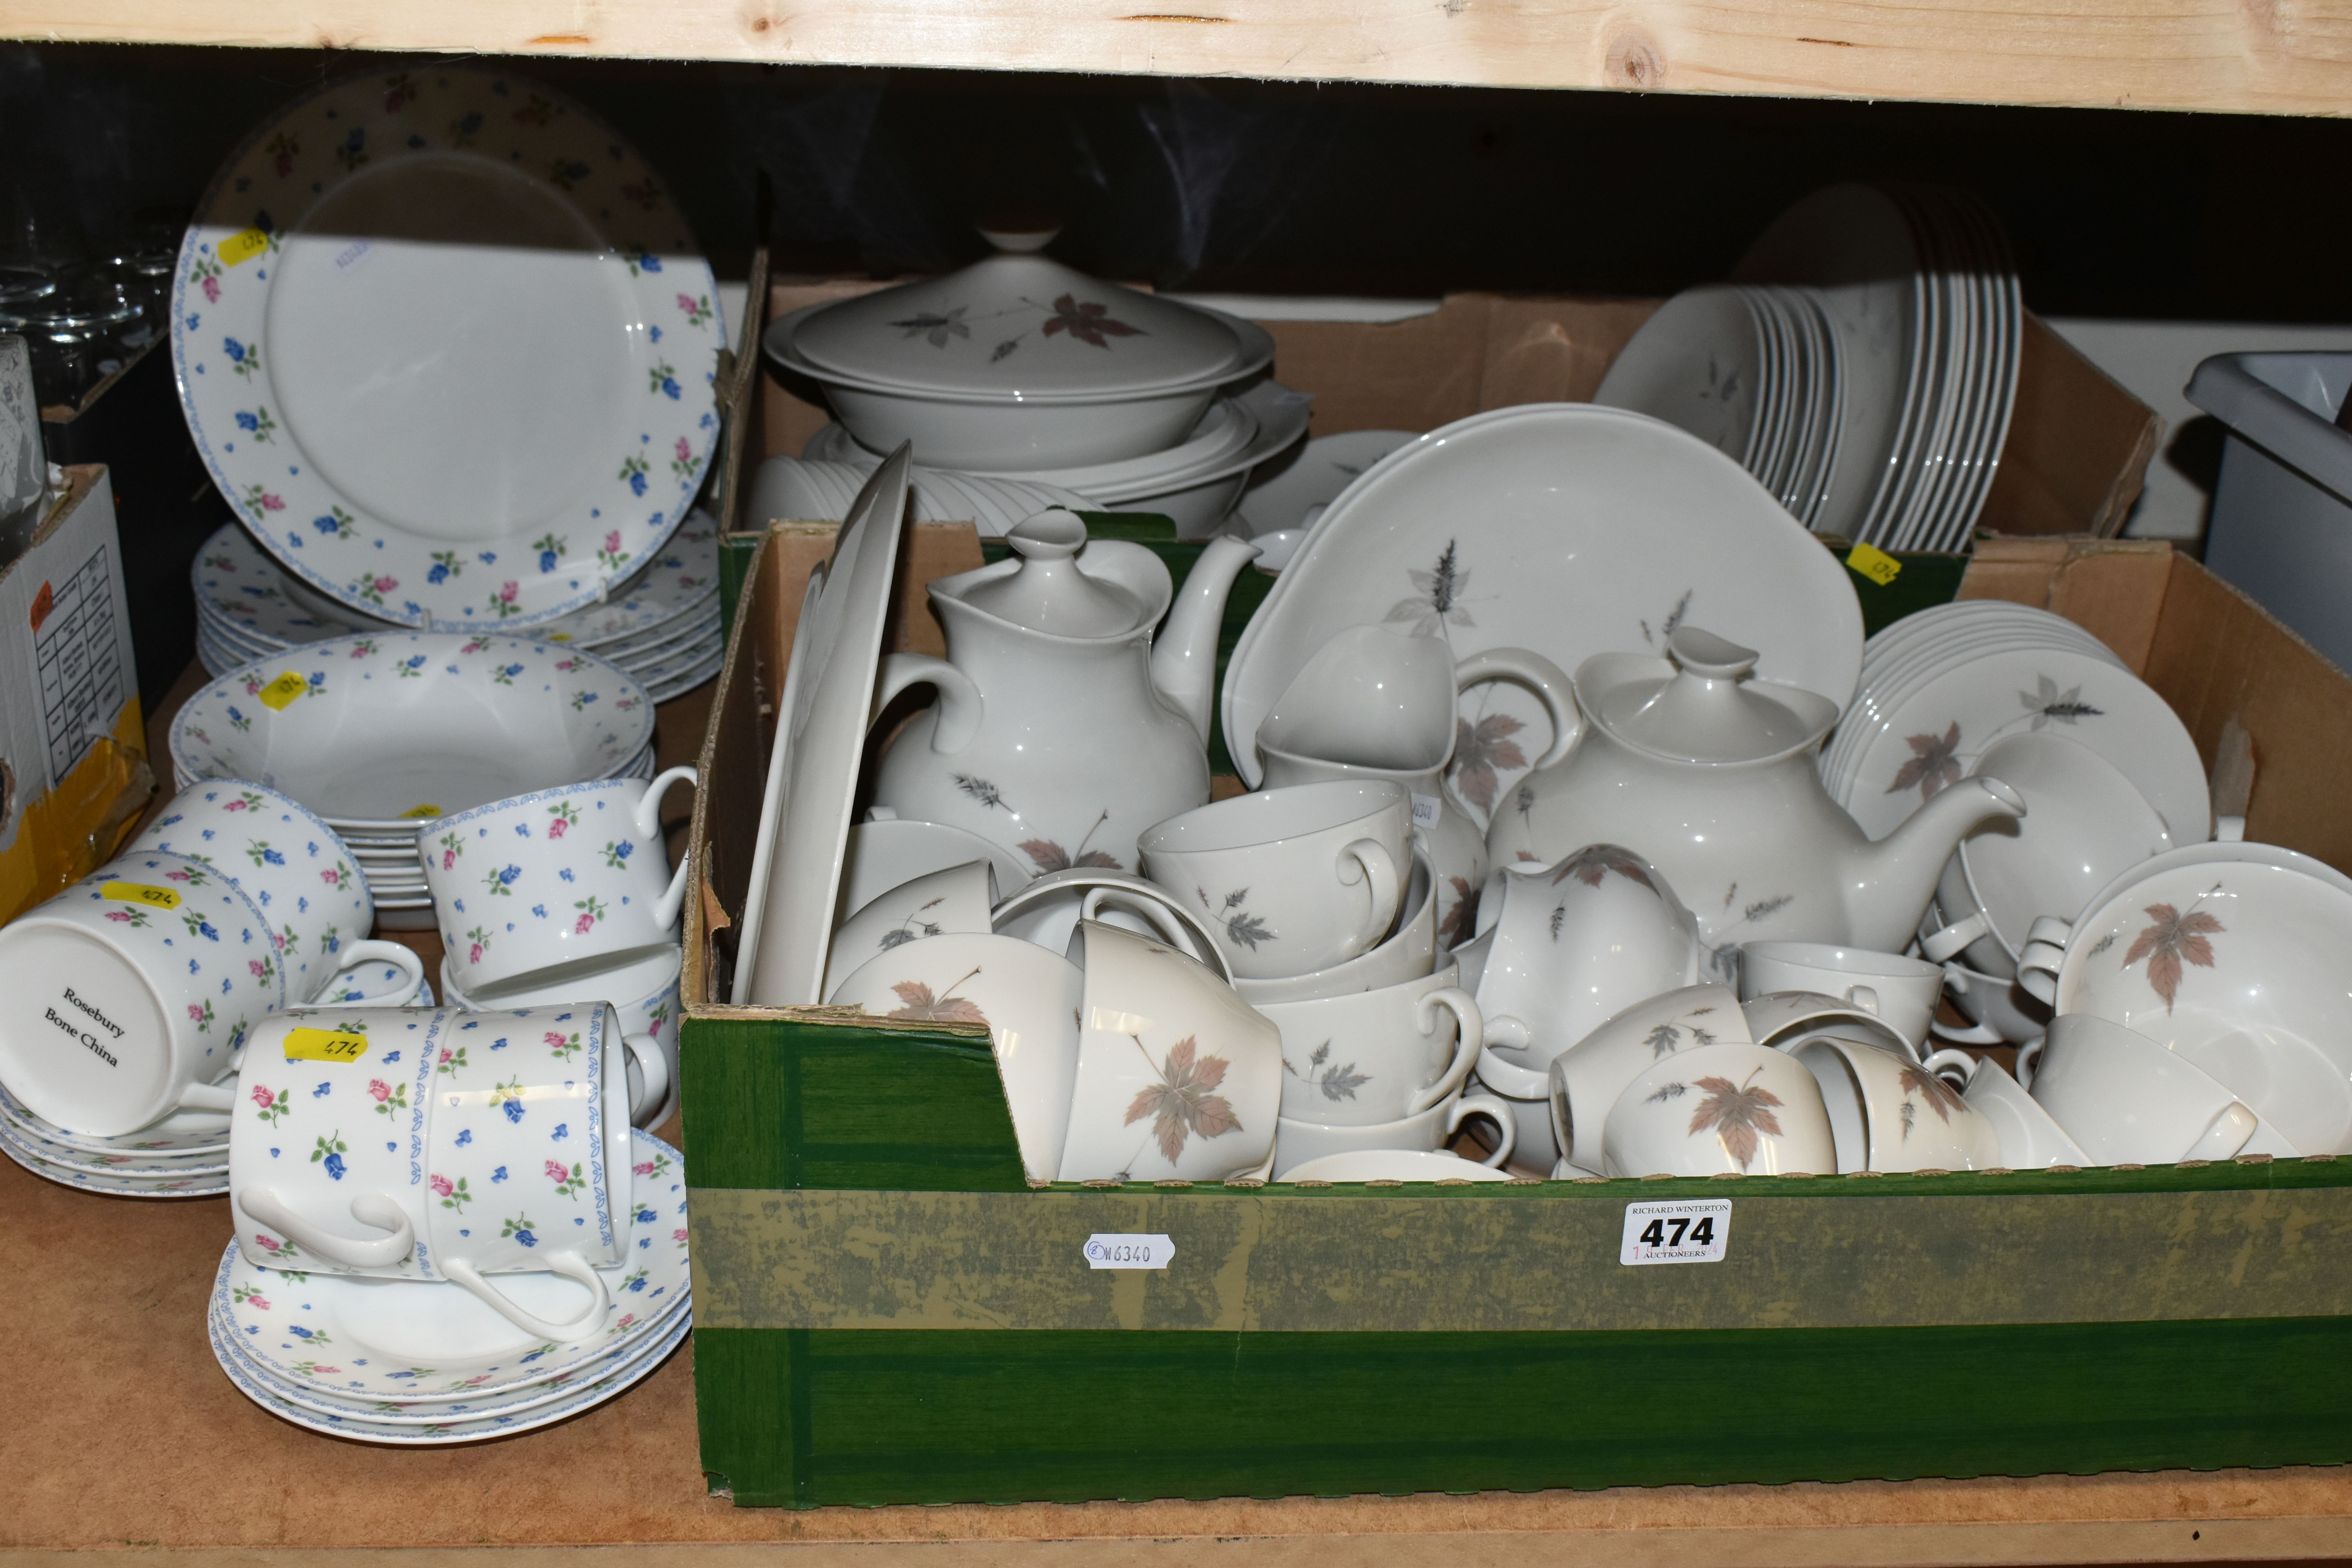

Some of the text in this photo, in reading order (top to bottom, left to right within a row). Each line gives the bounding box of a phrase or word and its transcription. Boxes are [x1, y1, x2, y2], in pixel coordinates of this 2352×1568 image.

[142, 890, 172, 904] 474
[63, 987, 125, 1038] Rosebury
[45, 1007, 118, 1067] Bone China
[324, 1040, 357, 1056] 474
[1676, 1204, 1729, 1212] WINTERTON
[1640, 1217, 1714, 1247] 474
[1105, 1245, 1150, 1262] W6340
[1643, 1250, 1706, 1259] AUCTIONEERS
